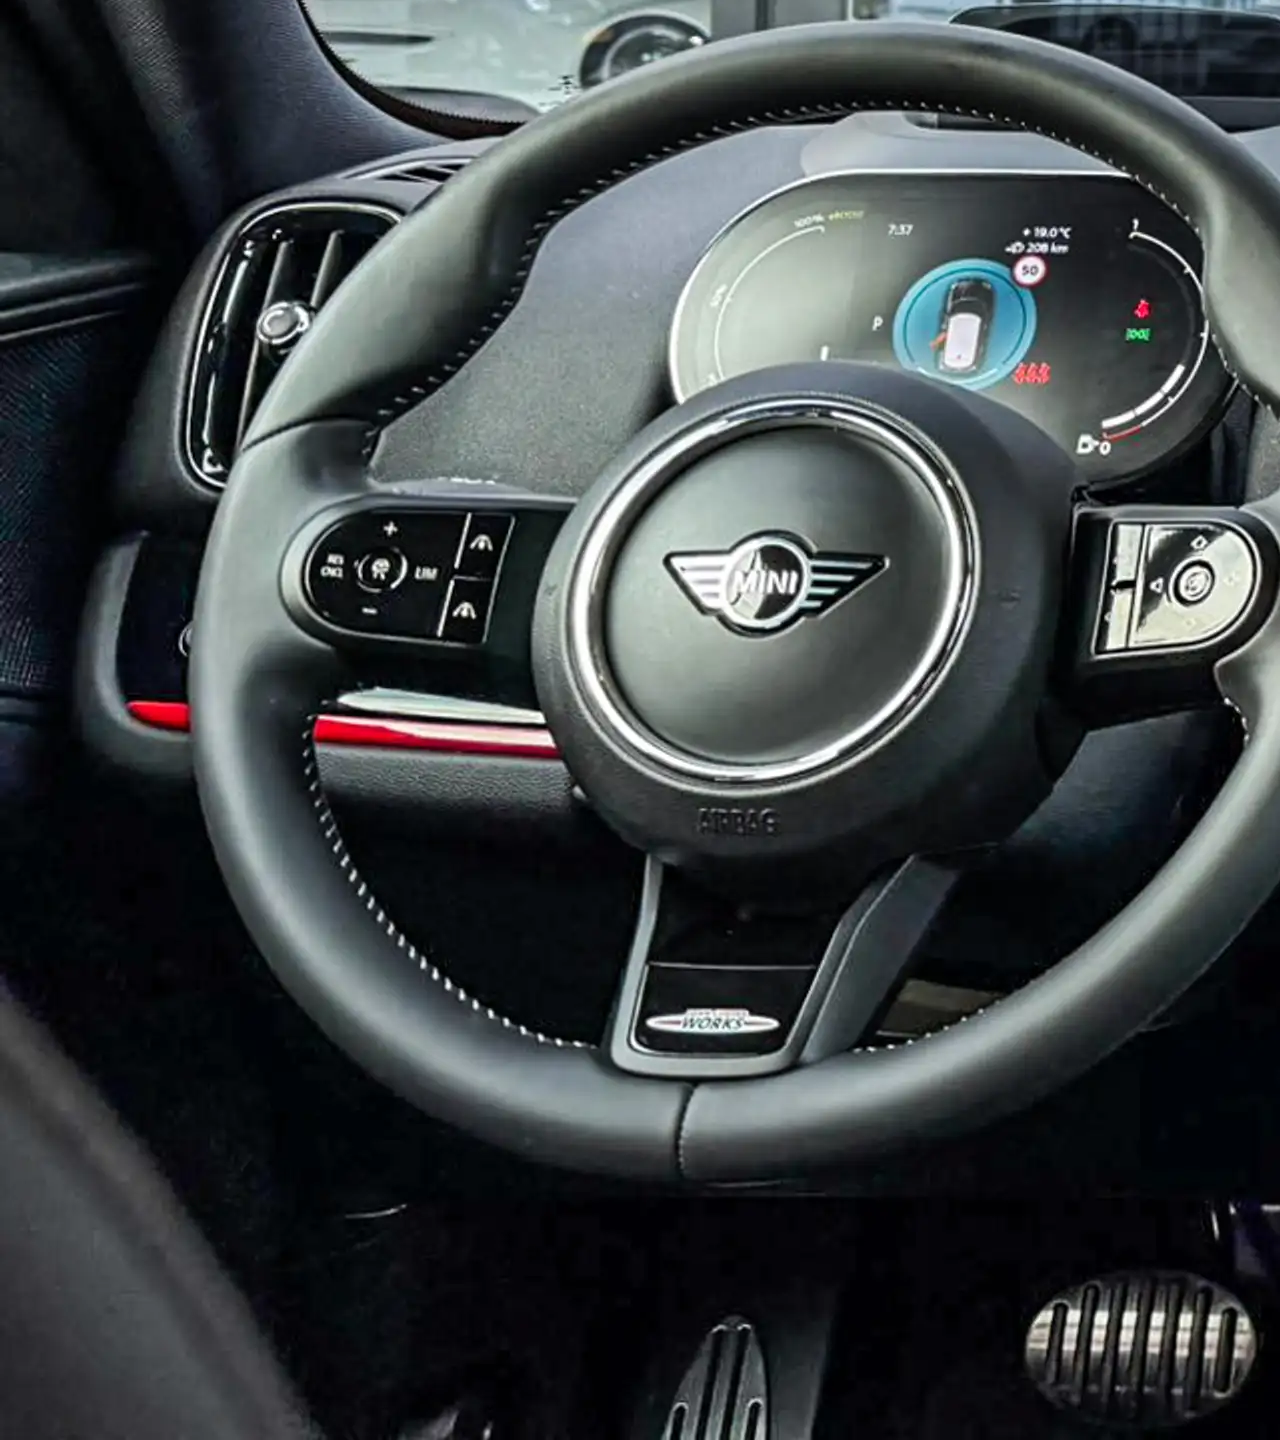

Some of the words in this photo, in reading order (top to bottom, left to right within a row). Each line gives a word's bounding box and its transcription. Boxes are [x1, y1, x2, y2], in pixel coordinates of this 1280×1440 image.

[1051, 241, 1069, 254] km
[1021, 263, 1039, 277] 50
[871, 315, 884, 331] P
[413, 566, 438, 580] LIM
[734, 569, 799, 594] MINI
[682, 1017, 746, 1030] WORKS
